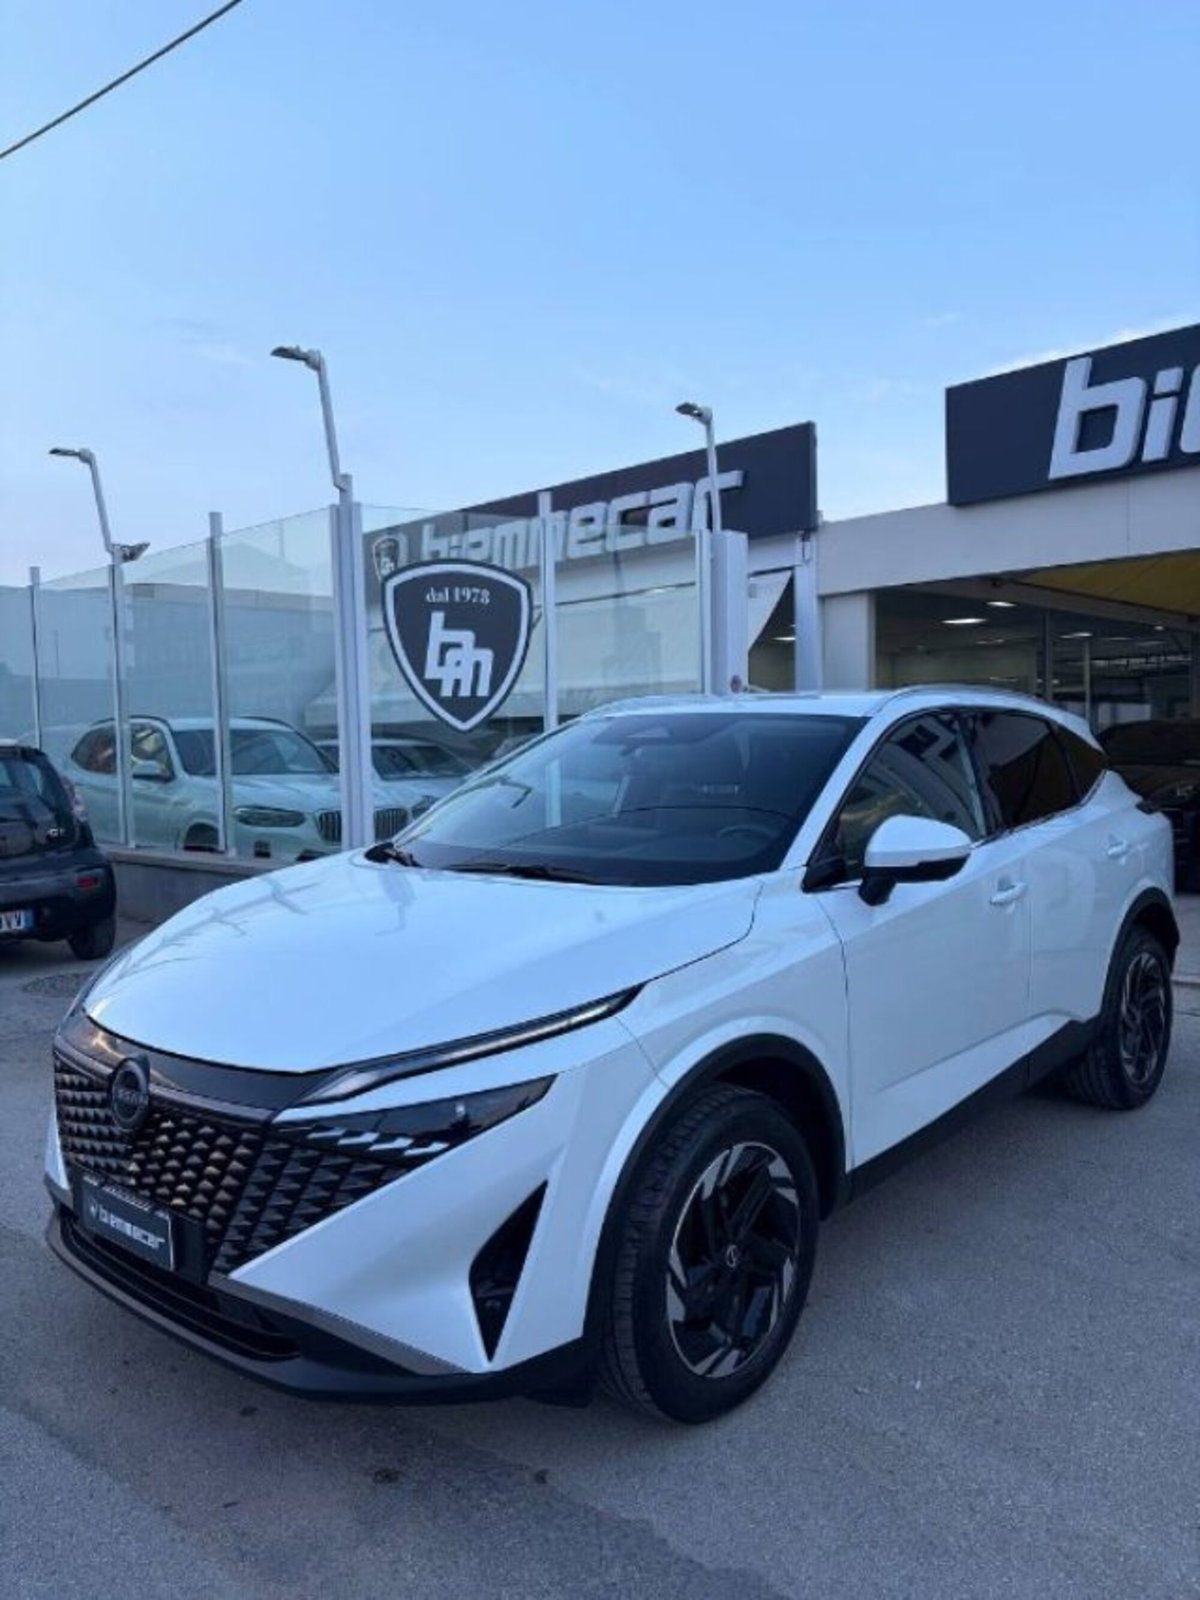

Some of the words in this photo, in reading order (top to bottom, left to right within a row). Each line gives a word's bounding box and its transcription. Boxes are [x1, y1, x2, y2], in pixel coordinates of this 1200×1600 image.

[1048, 356, 1200, 480] bi
[426, 587, 449, 602] dal
[454, 586, 490, 605] 1978
